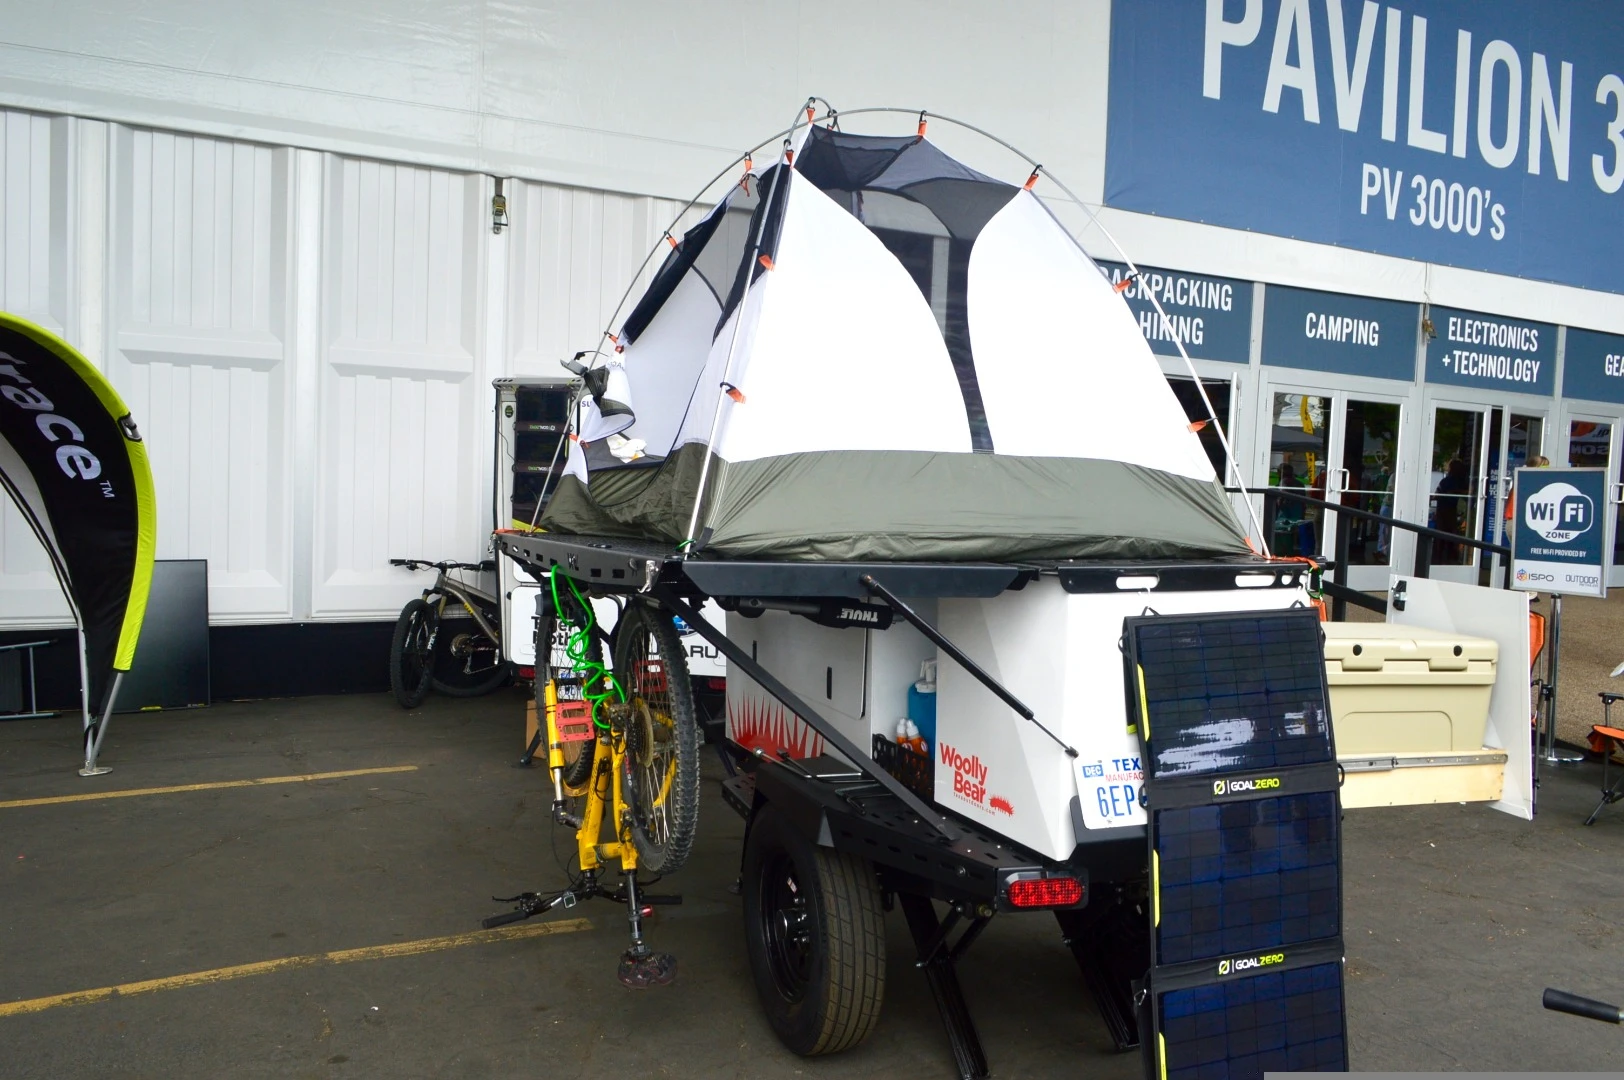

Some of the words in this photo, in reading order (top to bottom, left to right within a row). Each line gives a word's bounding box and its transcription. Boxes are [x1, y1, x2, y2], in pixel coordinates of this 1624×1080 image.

[1202, 0, 1573, 182] PAVILION
[1361, 163, 1402, 220] PV
[1410, 174, 1506, 241] 3000's
[1140, 310, 1204, 345] HIKING
[1305, 312, 1379, 347] CAMPING
[1447, 316, 1539, 352] ELECTRONICS
[1530, 547, 1542, 555] FREE
[1554, 549, 1579, 558] PROVIDED
[1545, 531, 1571, 540] ZONE
[1528, 573, 1555, 582] ISPO
[1565, 574, 1599, 585] OUTDOOR
[841, 608, 879, 623] THULE
[939, 742, 988, 786] Woolly
[1084, 765, 1102, 777] DEC
[1111, 757, 1143, 772] TEX
[953, 770, 987, 804] Bear
